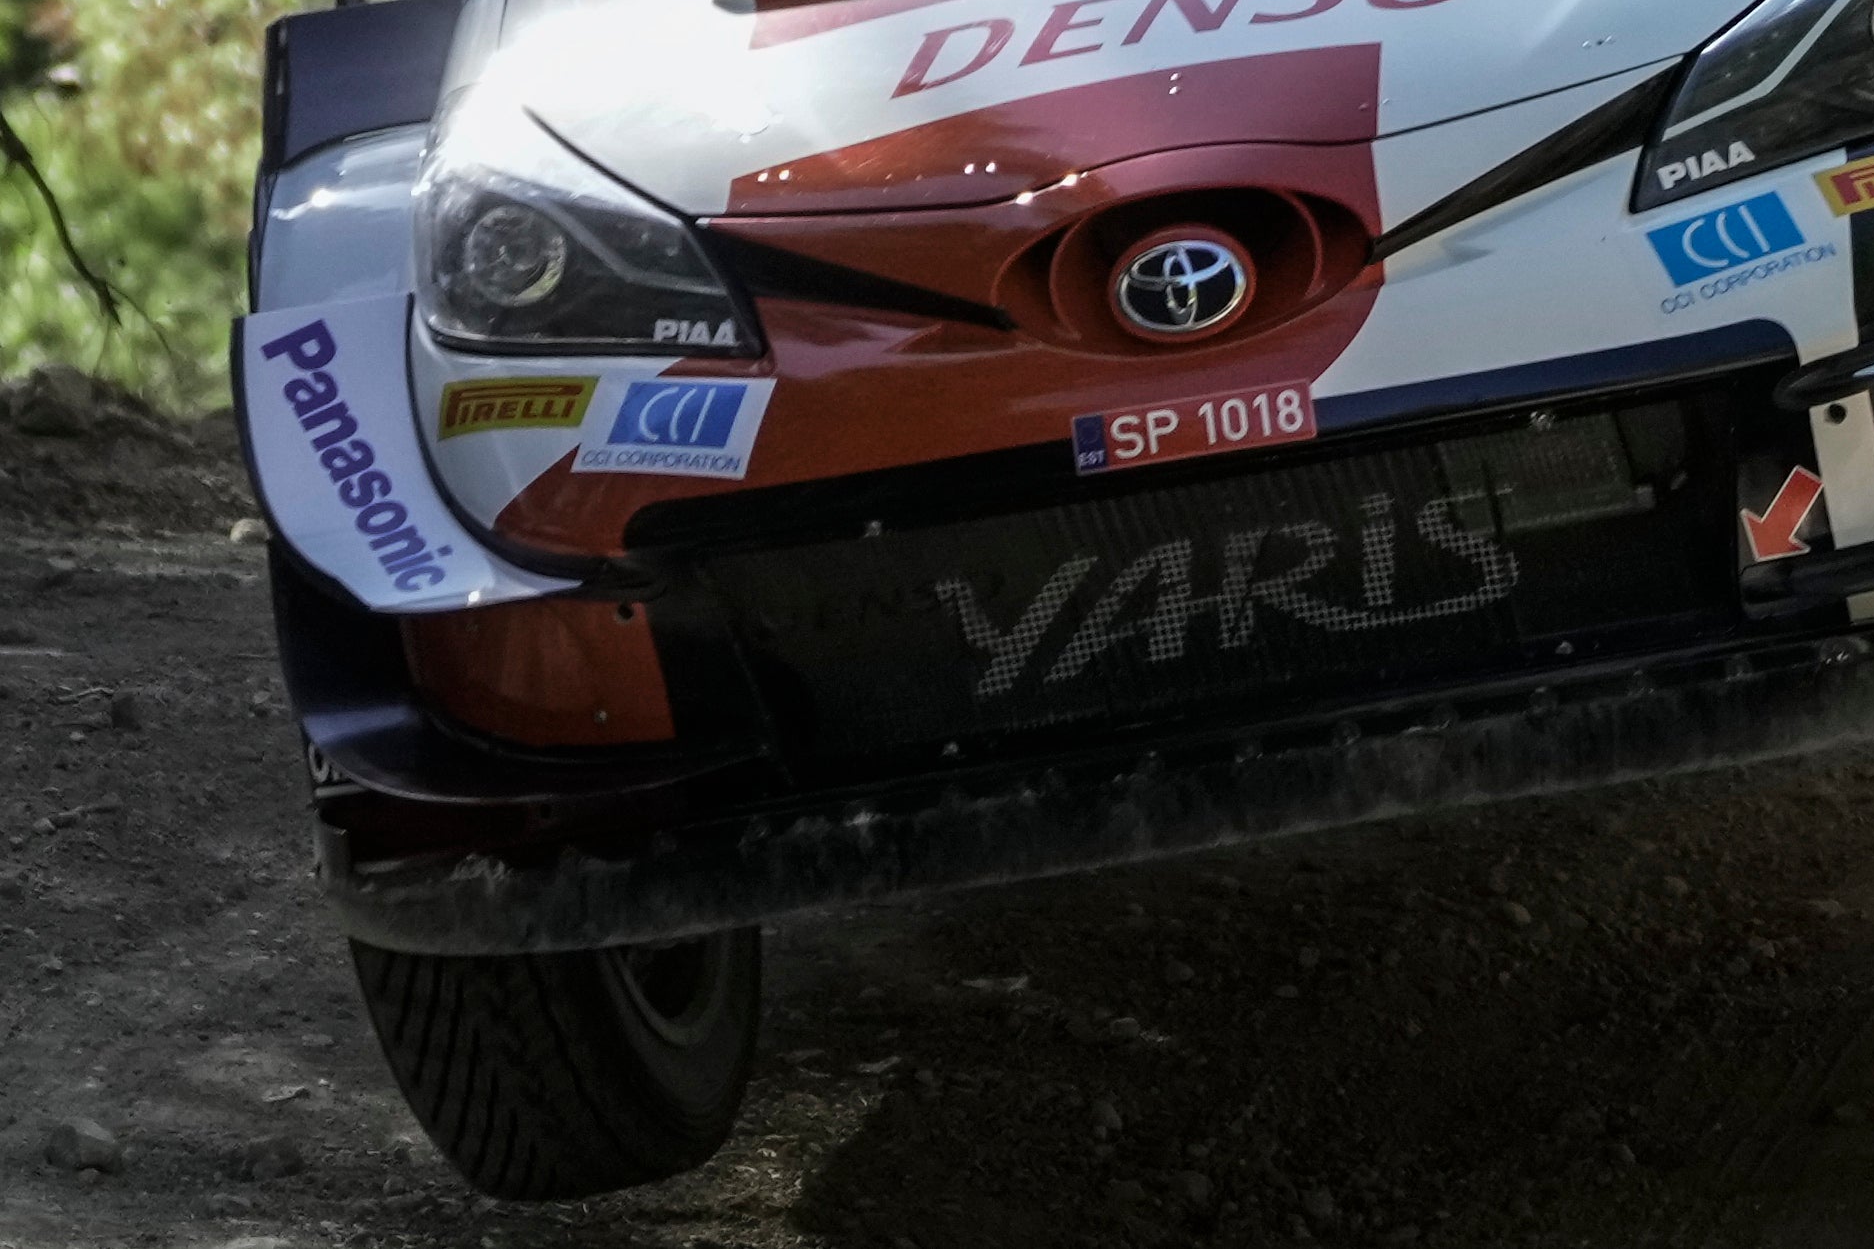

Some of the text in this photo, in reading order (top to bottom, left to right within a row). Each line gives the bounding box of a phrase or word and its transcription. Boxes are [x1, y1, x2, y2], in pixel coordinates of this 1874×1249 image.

[1656, 140, 1756, 191] PIAA
[1699, 242, 1837, 302] CORPORATION
[653, 318, 737, 345] PIAA
[444, 382, 584, 429] PIRELLI
[1109, 390, 1305, 460] SP 1018
[260, 319, 454, 593] Panasonic
[616, 451, 741, 471] CORPORATION
[1077, 450, 1105, 467] EST
[935, 487, 1520, 697] YARIS
